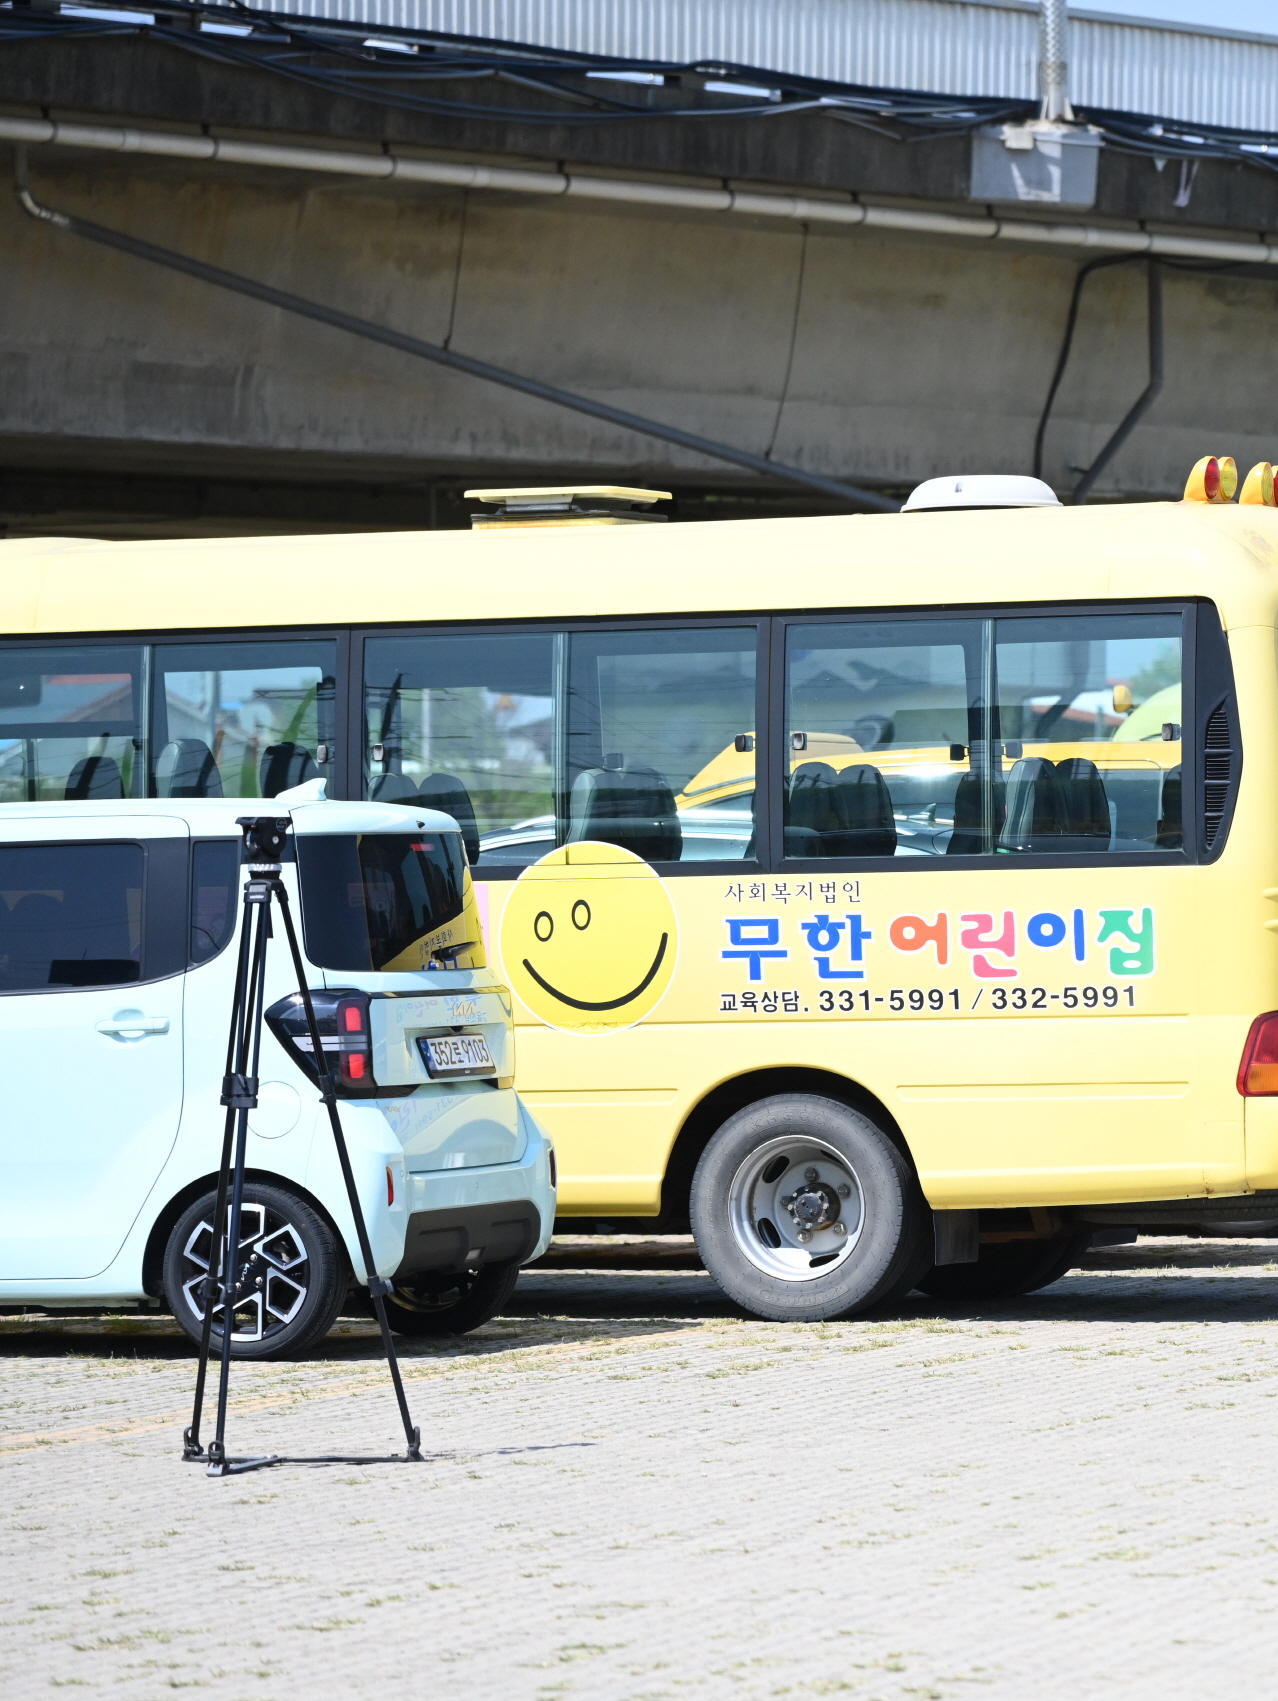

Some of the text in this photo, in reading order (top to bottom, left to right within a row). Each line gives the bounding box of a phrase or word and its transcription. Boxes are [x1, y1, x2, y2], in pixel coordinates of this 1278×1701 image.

[724, 880, 861, 905] 사회복지법인
[721, 907, 1154, 981] 무한 어린이집
[819, 988, 960, 1012] 331-5991
[991, 985, 1135, 1010] 332-5991
